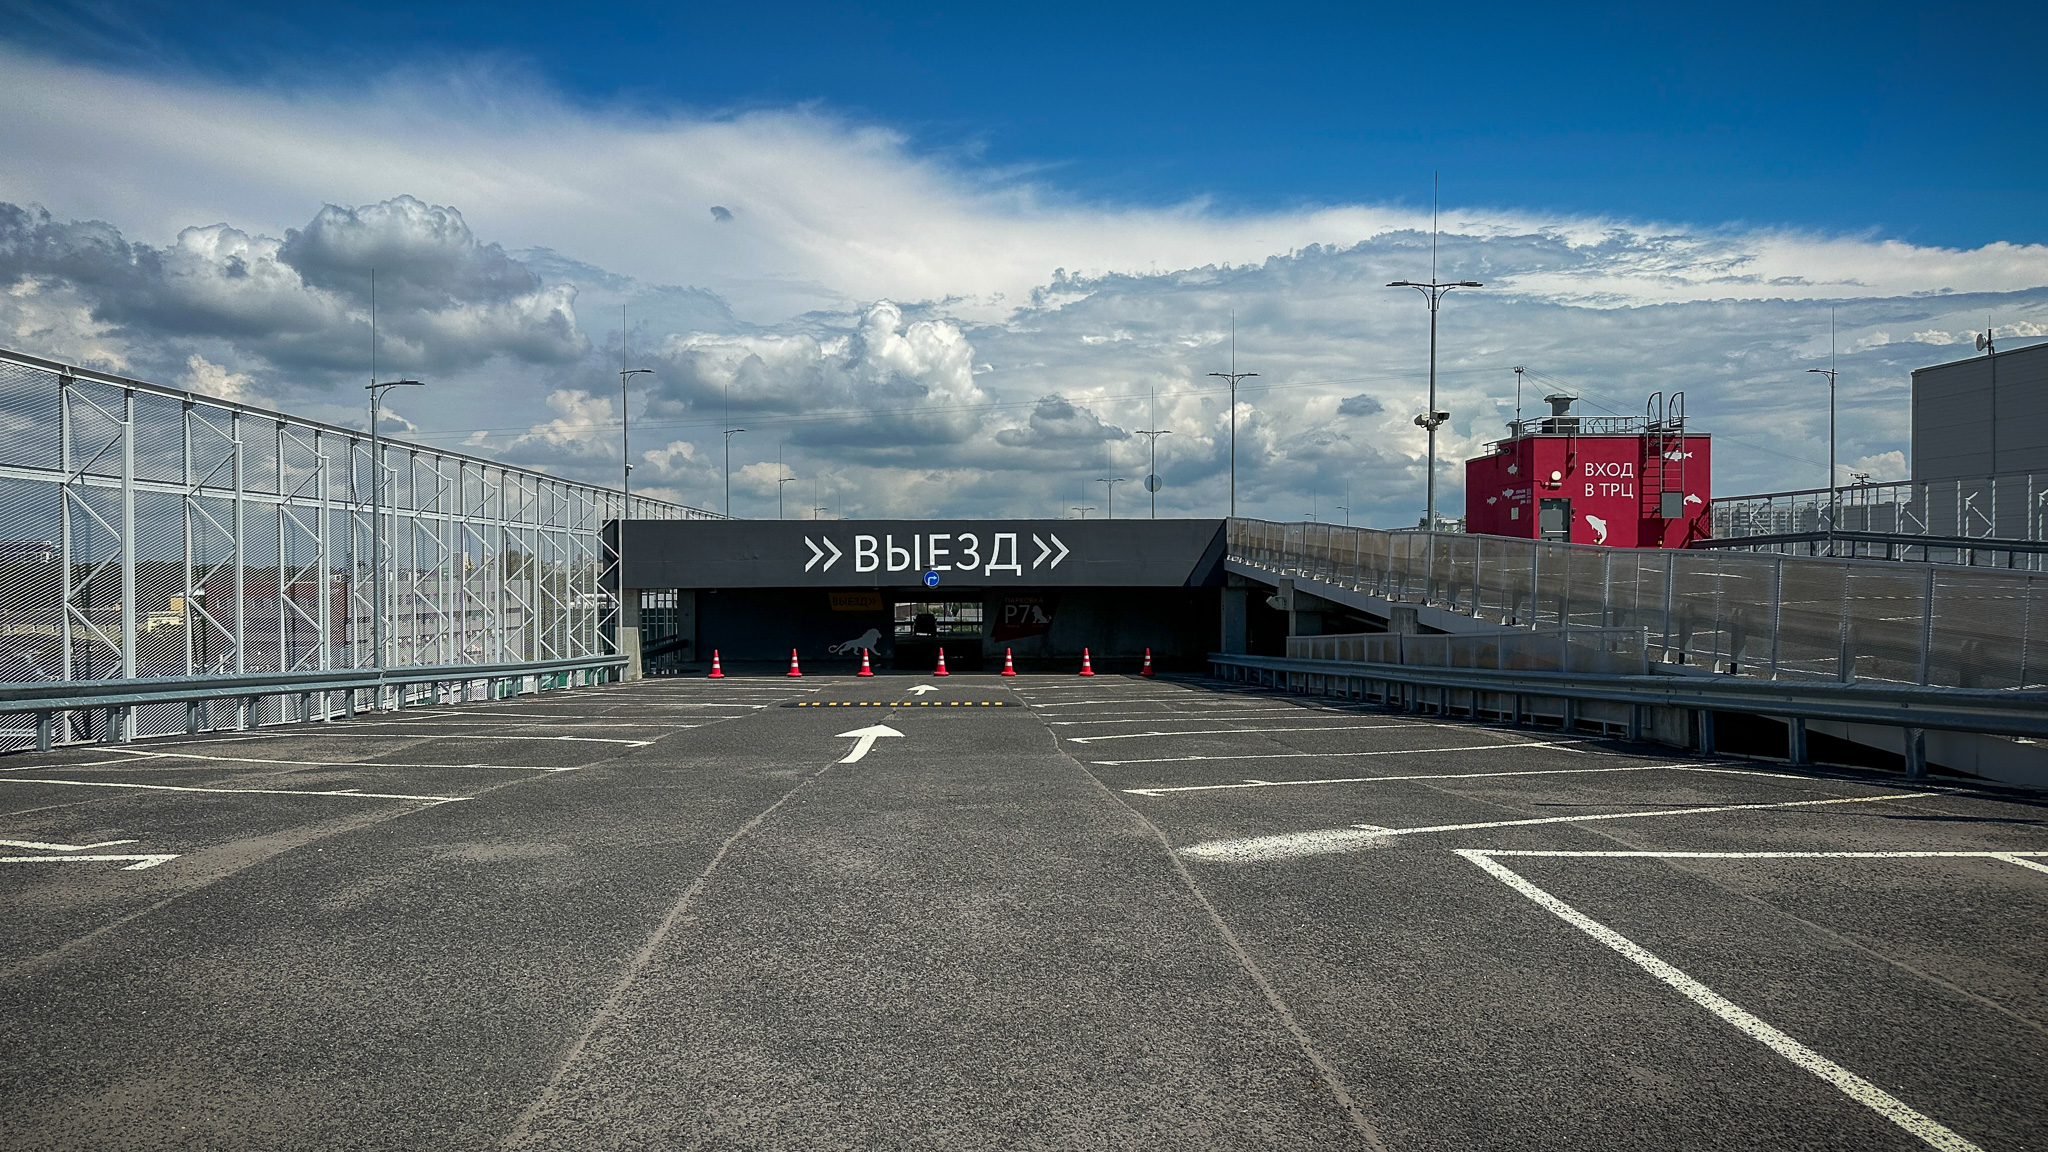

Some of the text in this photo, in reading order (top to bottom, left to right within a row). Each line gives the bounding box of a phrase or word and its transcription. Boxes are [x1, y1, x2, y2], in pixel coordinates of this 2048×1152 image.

[1585, 462, 1634, 479] ВХОД
[1585, 483, 1634, 499] В ТРЦ
[855, 532, 1022, 577] ВЫЕЗД
